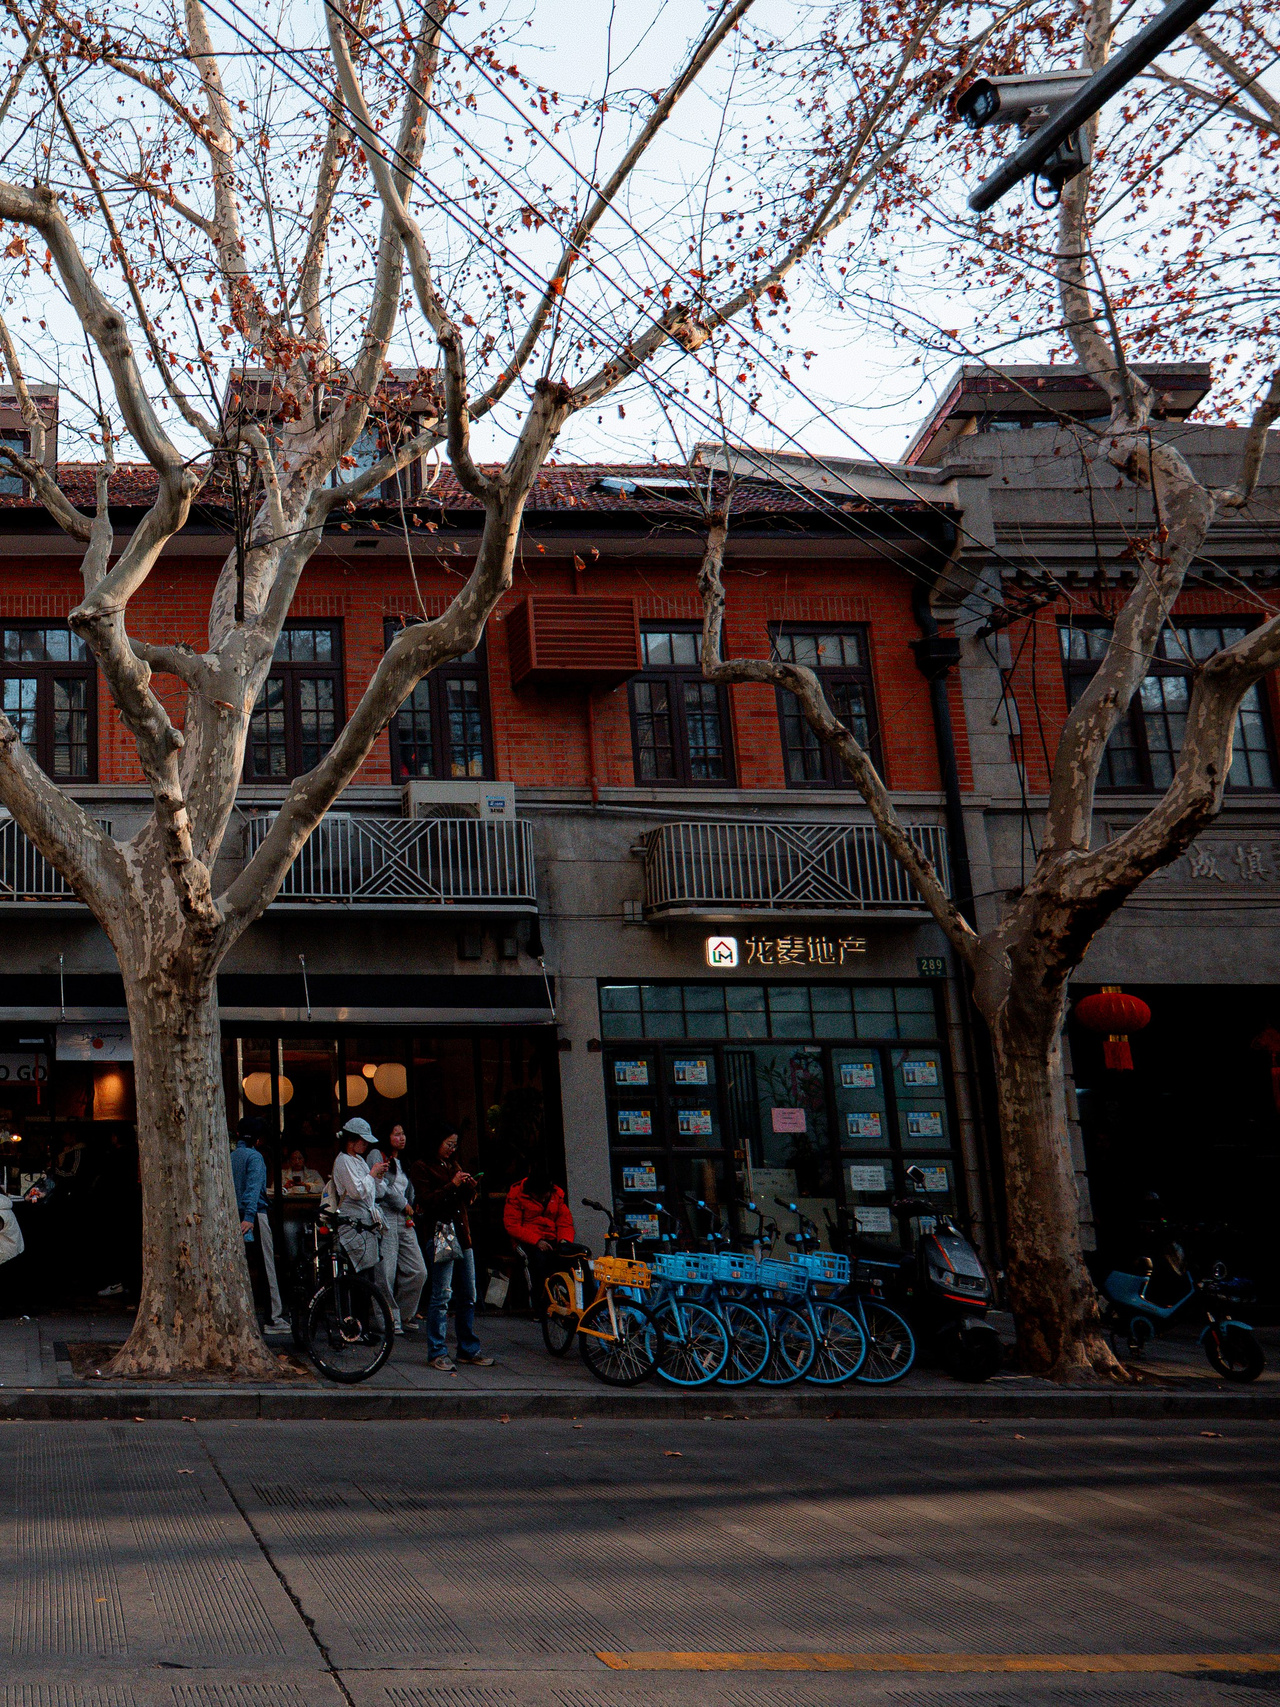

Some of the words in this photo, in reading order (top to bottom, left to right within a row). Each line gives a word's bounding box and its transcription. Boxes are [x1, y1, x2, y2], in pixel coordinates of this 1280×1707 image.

[745, 936, 866, 965] 龙麦地产
[921, 959, 942, 970] 289
[17, 1065, 47, 1081] GO
